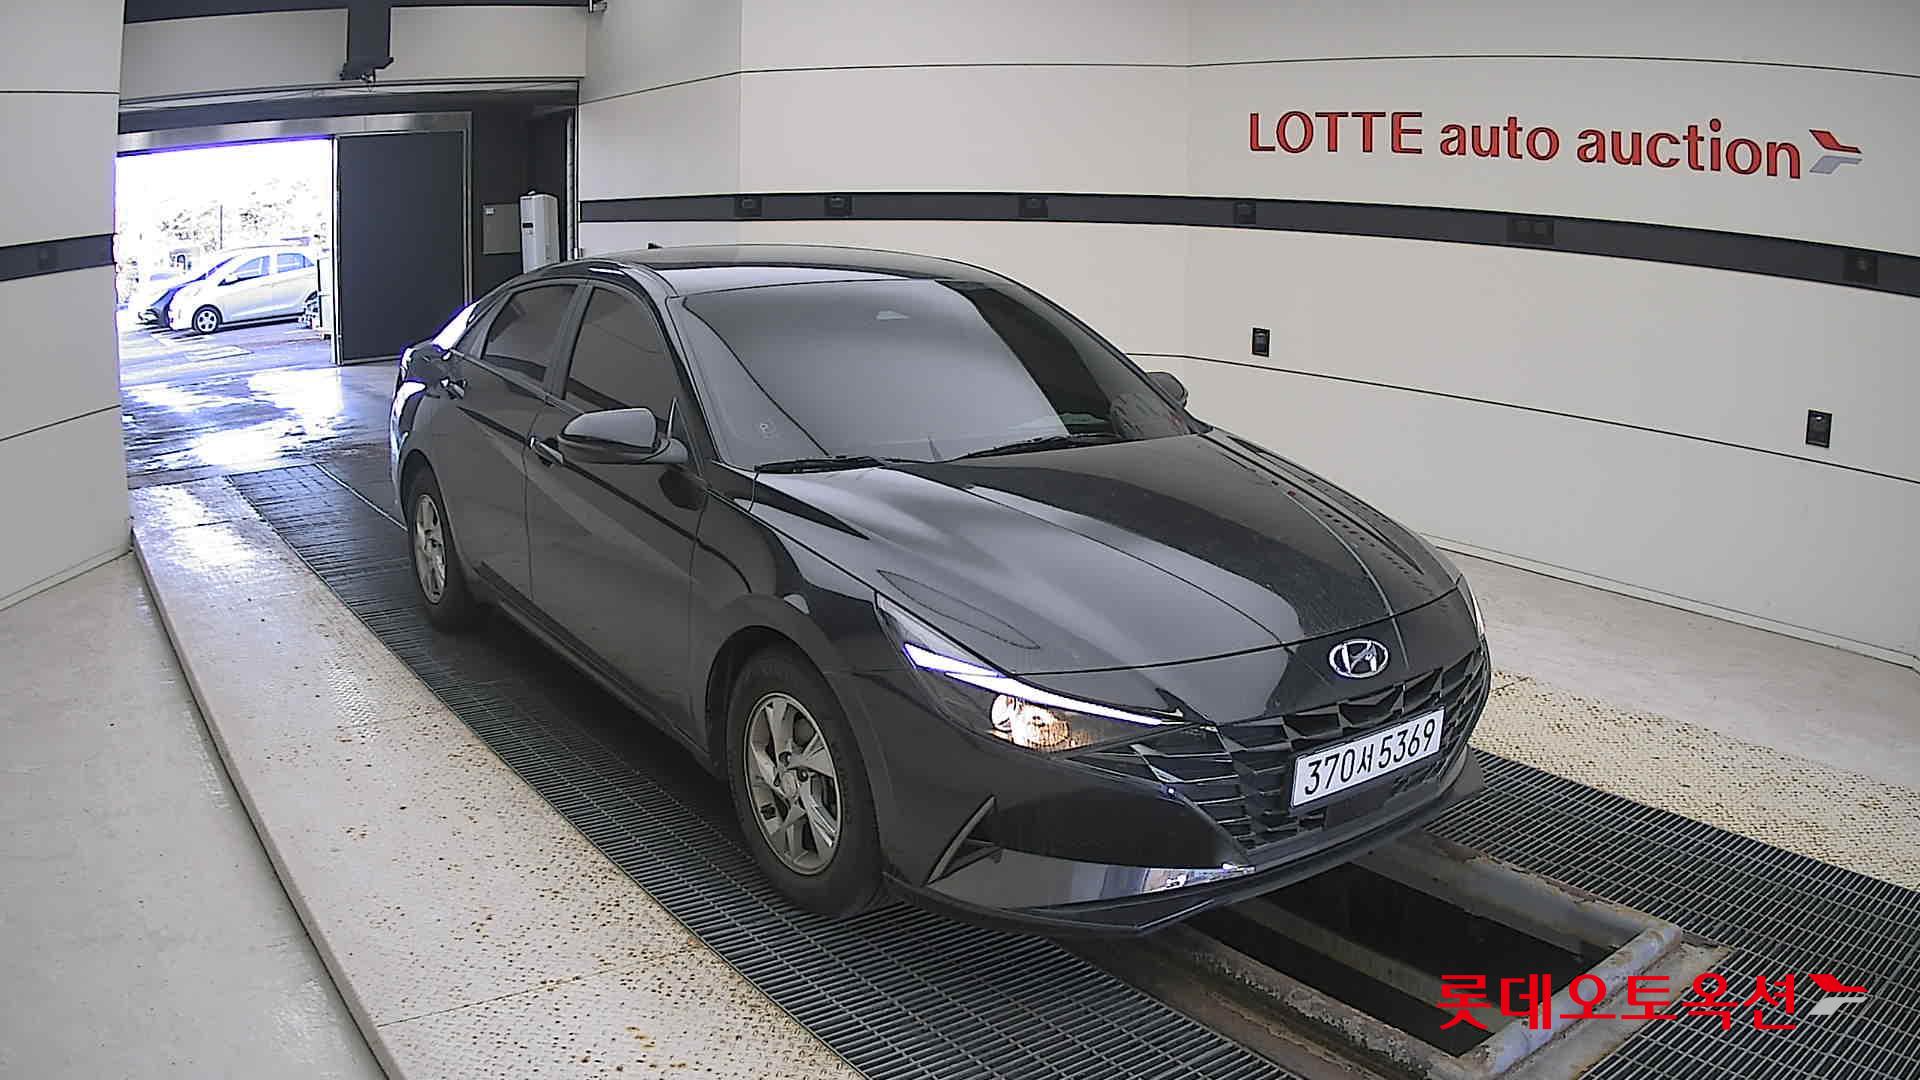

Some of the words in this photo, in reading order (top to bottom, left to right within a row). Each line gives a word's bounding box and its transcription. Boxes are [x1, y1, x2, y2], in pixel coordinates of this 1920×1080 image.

[1248, 111, 1424, 155] LOTTE
[1439, 115, 1561, 160] auto
[1575, 118, 1802, 180] auction
